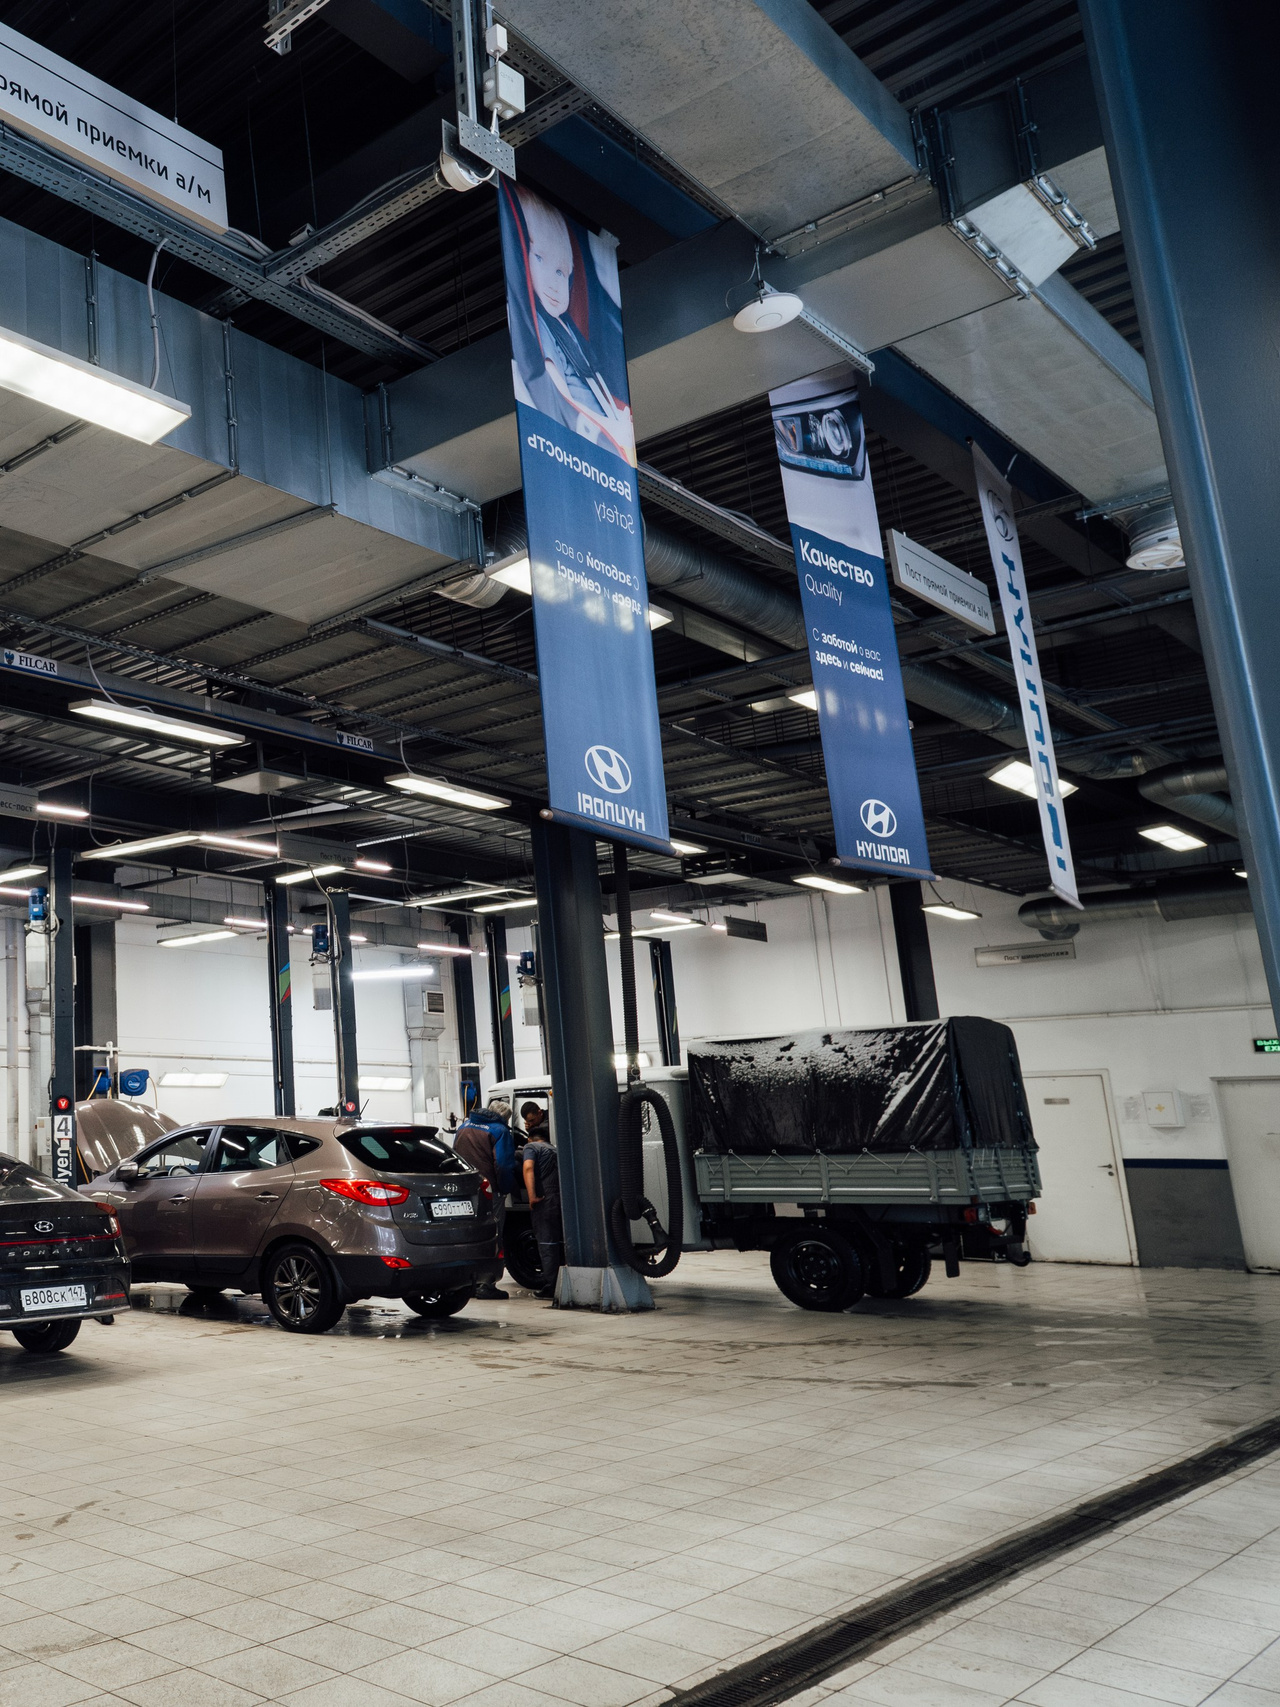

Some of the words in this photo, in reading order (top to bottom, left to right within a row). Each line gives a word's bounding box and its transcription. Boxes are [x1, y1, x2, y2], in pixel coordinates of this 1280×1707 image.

[76, 116, 168, 180] приемки
[175, 171, 212, 204] а/м
[800, 538, 874, 587] Качество
[804, 574, 843, 606] Quality
[904, 562, 922, 583] Пост
[923, 575, 949, 598] прямой
[949, 590, 977, 613] приемки
[812, 627, 820, 642] С
[821, 632, 858, 655] заботой
[859, 646, 864, 656] о
[865, 647, 881, 662] вас
[19, 655, 56, 673] FILCAR
[815, 650, 842, 668] здесь
[843, 660, 849, 670] и
[849, 661, 884, 681] сейчас!
[347, 736, 373, 749] FILCAR
[856, 840, 911, 865] HYUNDAI
[7, 1247, 83, 1257] SONATA
[68, 1286, 83, 1297] 147
